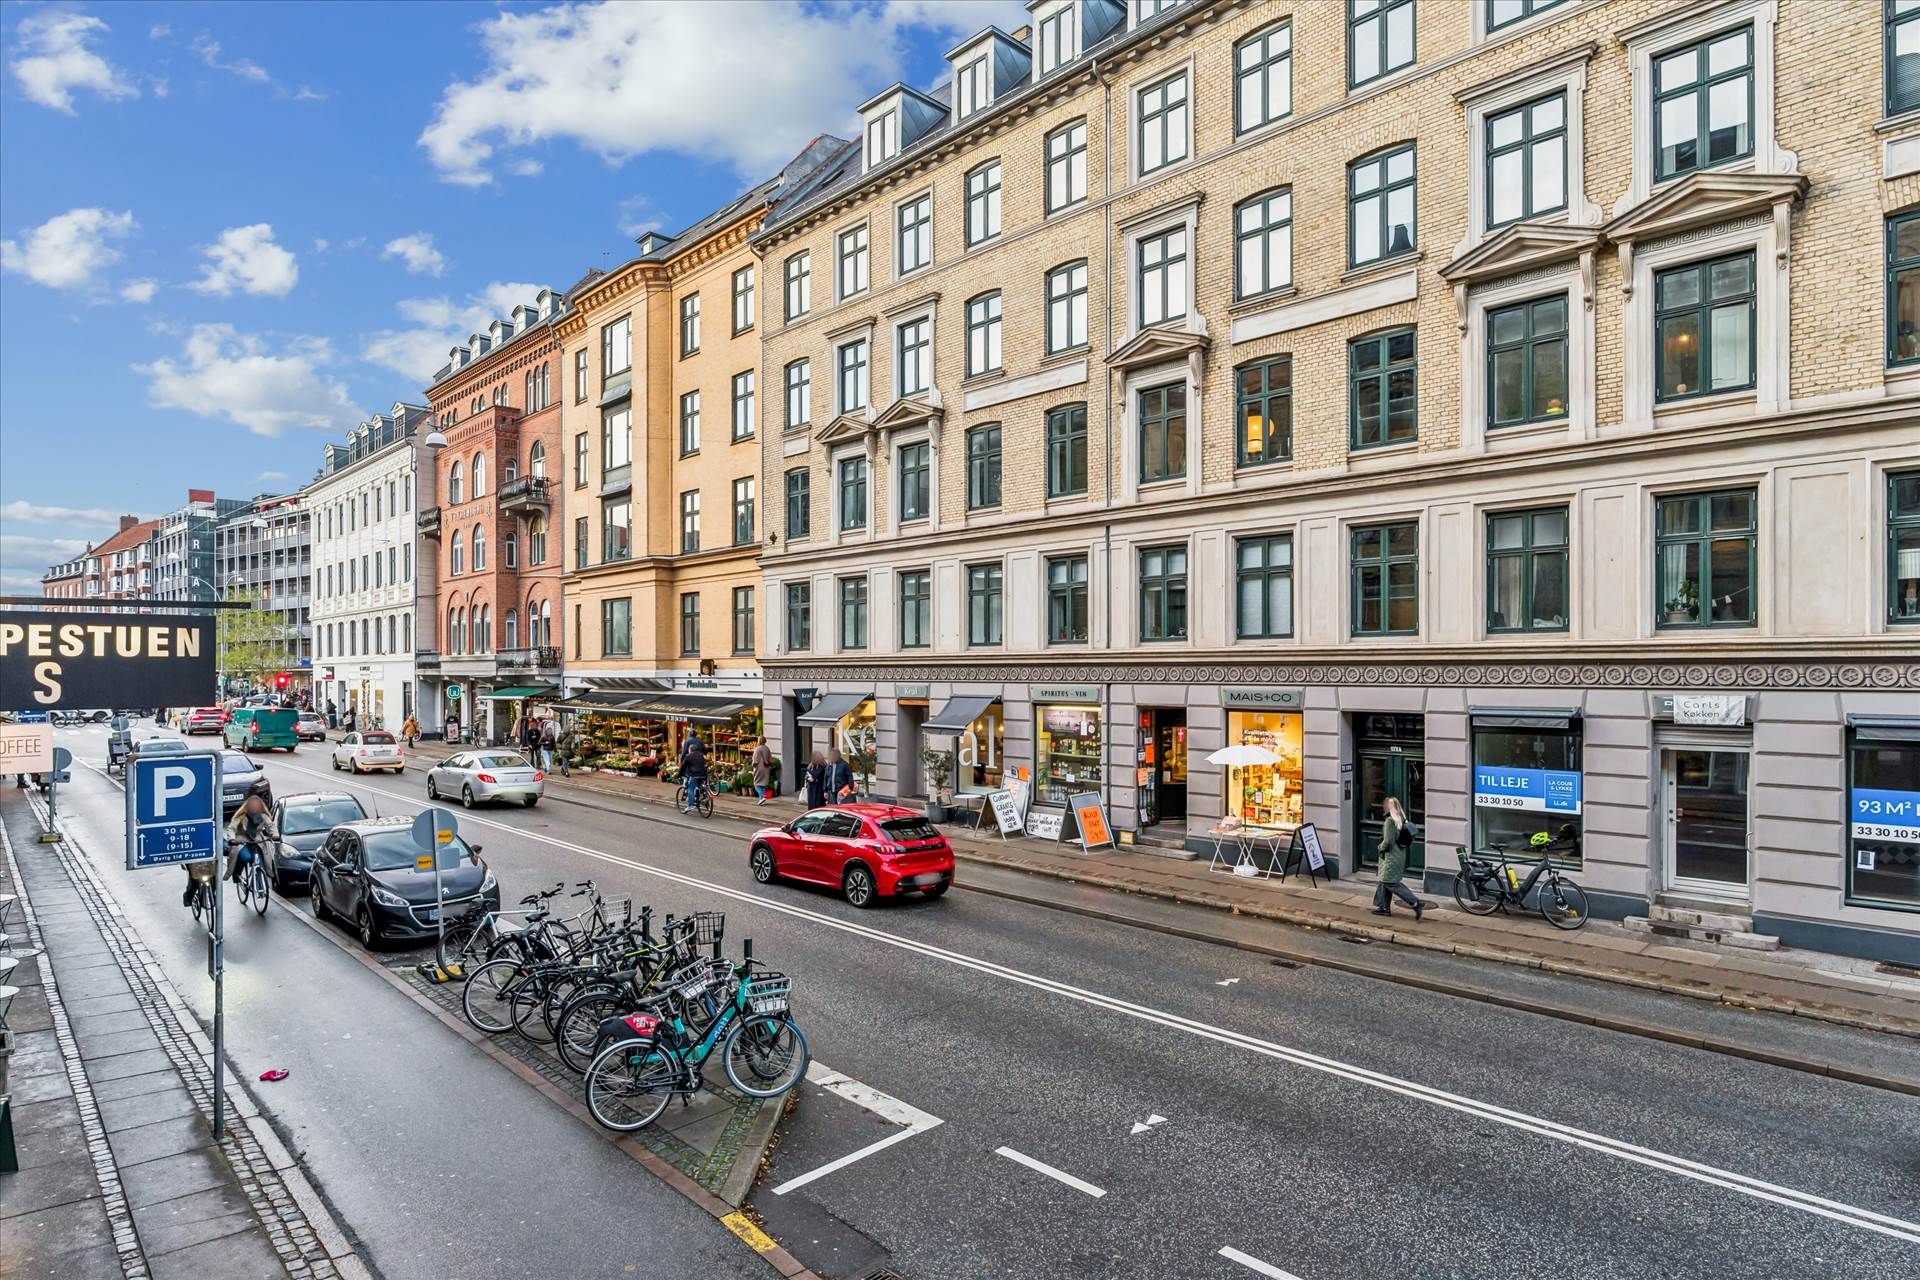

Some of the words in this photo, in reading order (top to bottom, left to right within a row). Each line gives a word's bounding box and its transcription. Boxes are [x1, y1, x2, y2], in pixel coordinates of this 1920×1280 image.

[0, 624, 200, 658] PESTUEN
[1230, 692, 1292, 702] MAIS+CO
[1683, 700, 1721, 709] Carls
[1479, 775, 1498, 786] TIL
[1501, 776, 1529, 789] LEJE
[153, 766, 197, 817] P
[1478, 795, 1489, 804] 33
[1490, 796, 1500, 805] 30
[1502, 797, 1512, 806] 10
[1513, 798, 1524, 807] 50
[1858, 799, 1881, 814] 93
[1857, 826, 1872, 836] 33
[1875, 827, 1891, 837] 30
[1893, 828, 1909, 839] 10
[166, 842, 193, 850] (9-15)
